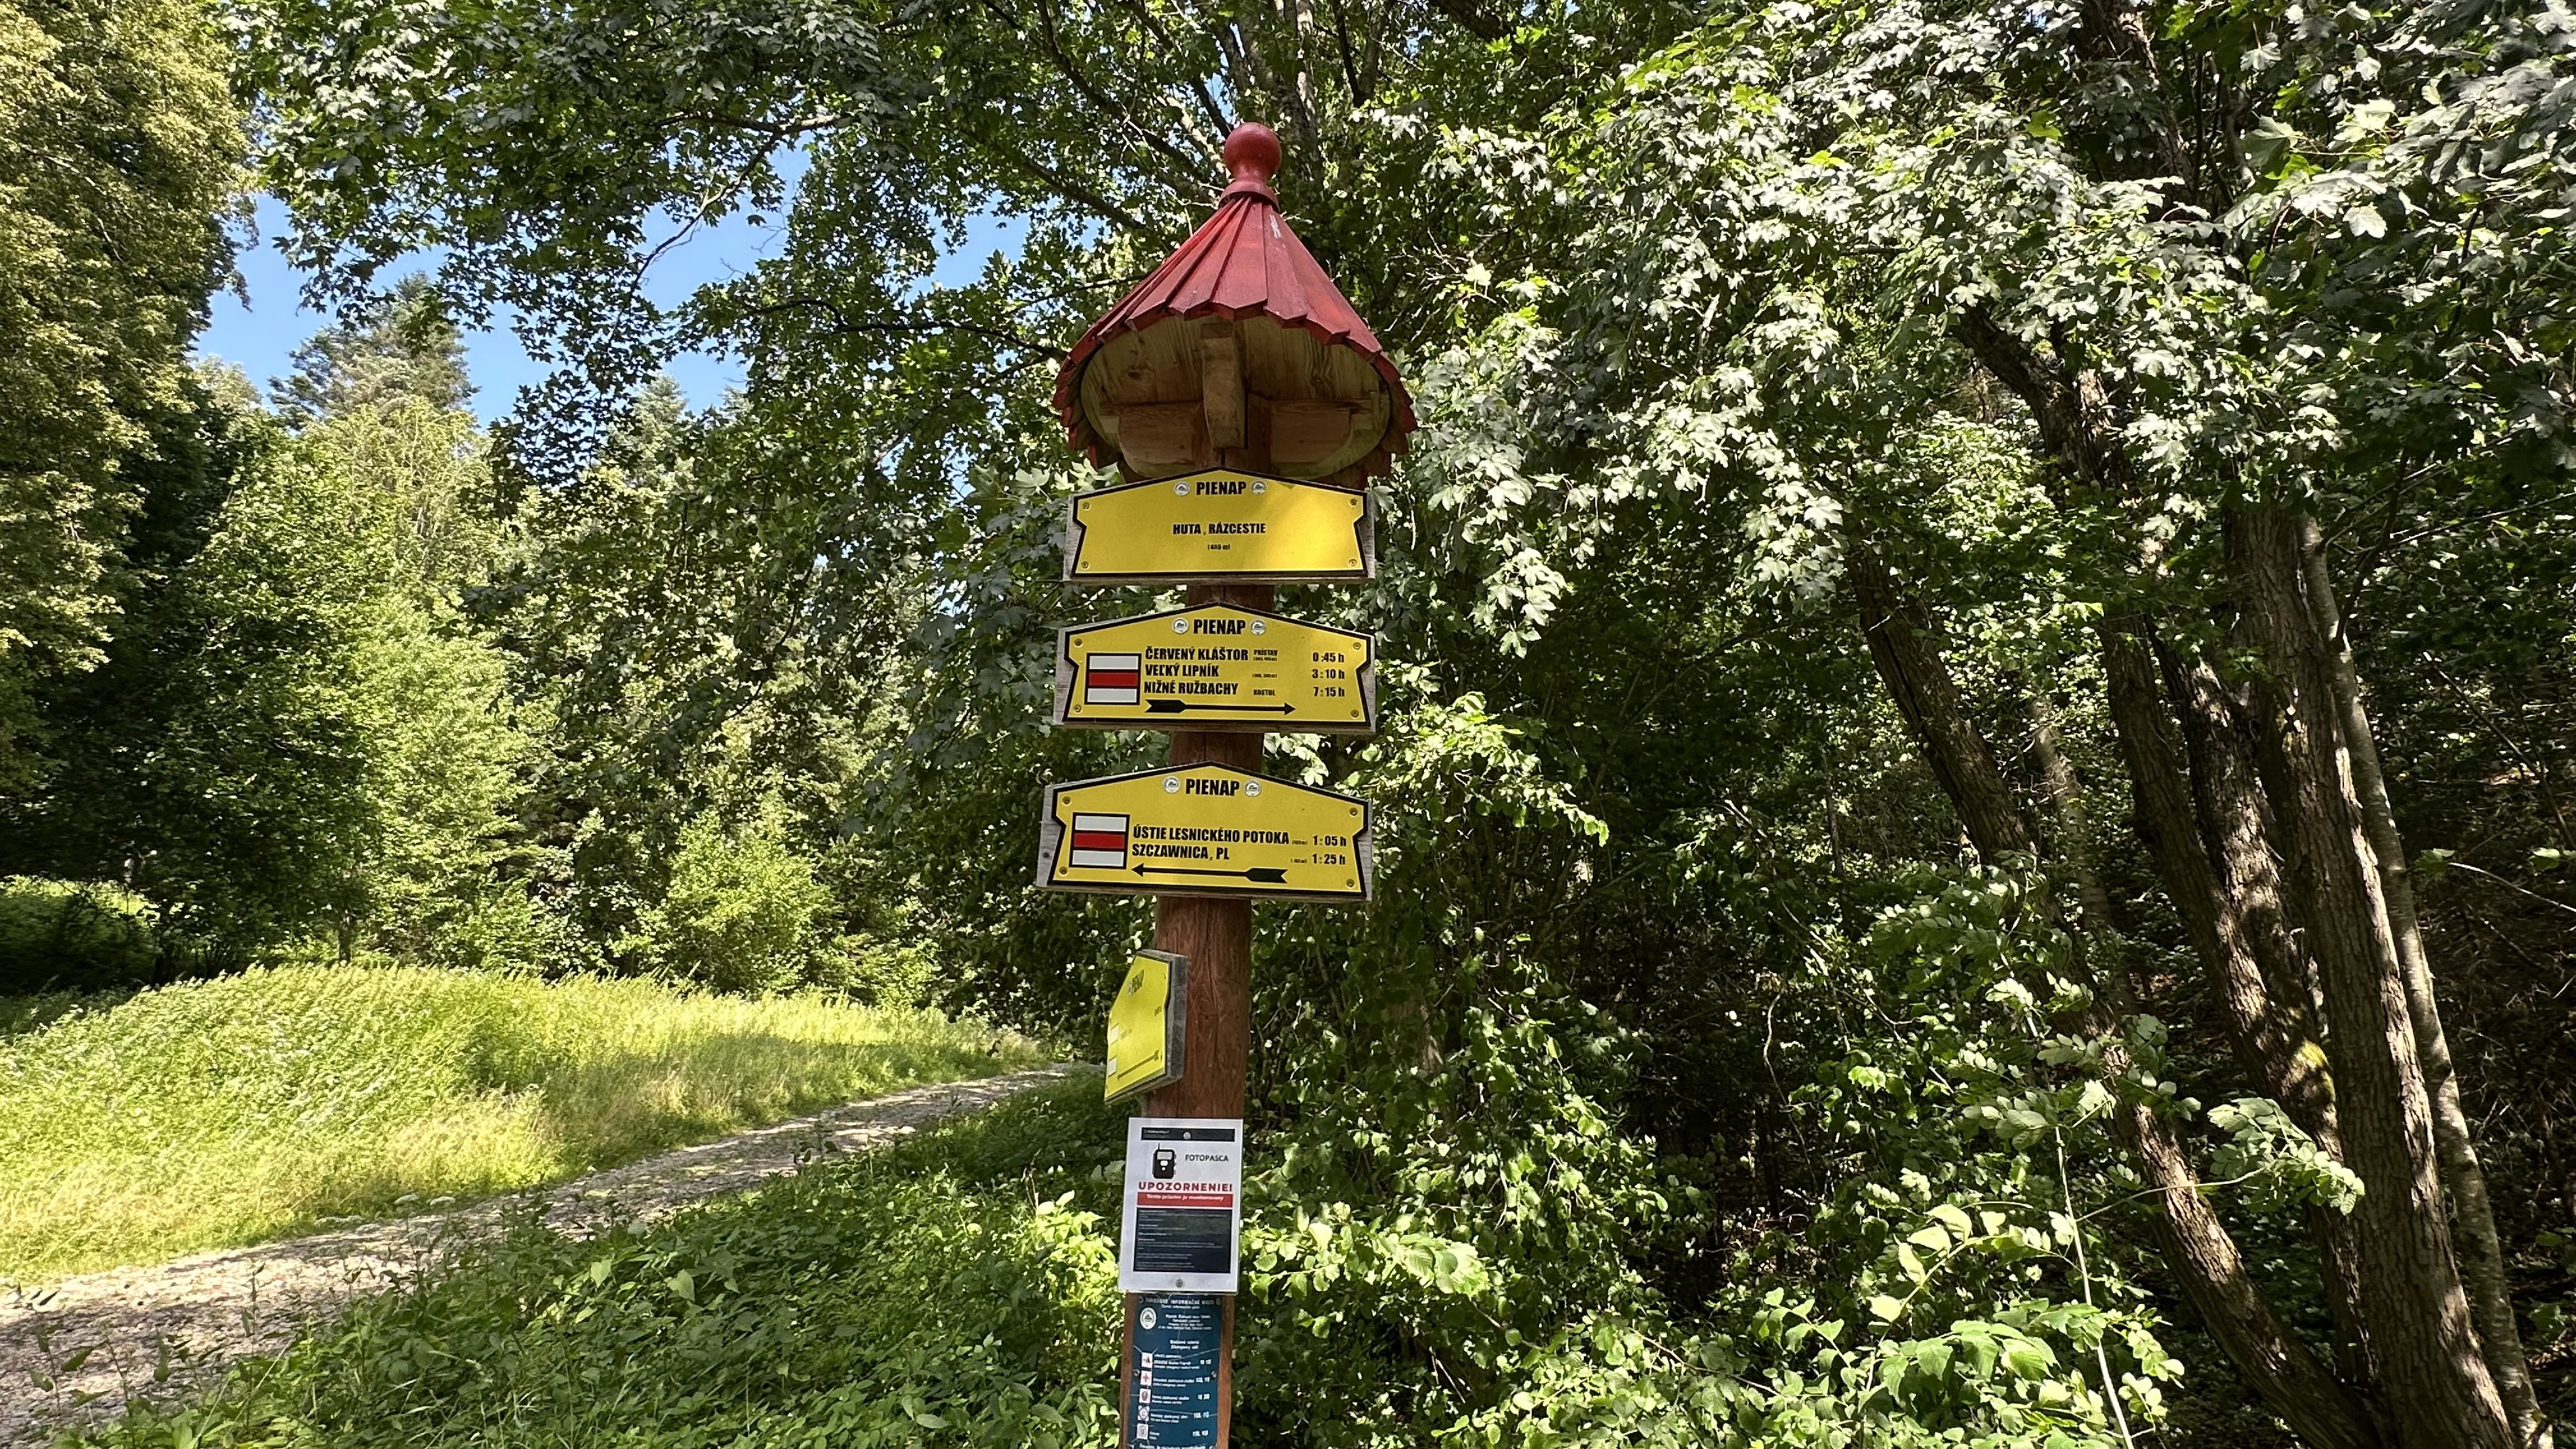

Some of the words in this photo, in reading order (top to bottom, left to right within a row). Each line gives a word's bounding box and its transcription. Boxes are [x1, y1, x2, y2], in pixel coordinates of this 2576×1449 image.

[1196, 481, 1246, 496] PIENAP
[1209, 521, 1266, 534] RÁZCESTIE
[1193, 619, 1246, 634] PIENAP
[1146, 646, 1195, 660] ČERVENÝ
[1198, 647, 1248, 660] KLÁŠTOR
[1338, 653, 1345, 663] h
[1146, 663, 1180, 676] VEĽKÝ
[1183, 663, 1219, 677] LIPNÍK
[1338, 670, 1345, 679] h
[1144, 680, 1176, 694] NIŽNÉ
[1179, 680, 1238, 694] RUŽBACHY
[1338, 687, 1345, 697] h
[1186, 779, 1239, 796] PIENAP
[1133, 824, 1167, 839] ÚSTIE
[1169, 827, 1240, 842] LESNICKÉHO
[1243, 831, 1289, 844] POTOKA
[1340, 836, 1347, 847] h
[1132, 843, 1213, 861] SZCZAWNICA,
[1216, 847, 1229, 860] PL
[1339, 854, 1346, 864] h
[1138, 1181, 1232, 1192] UPOZORNENIE!
